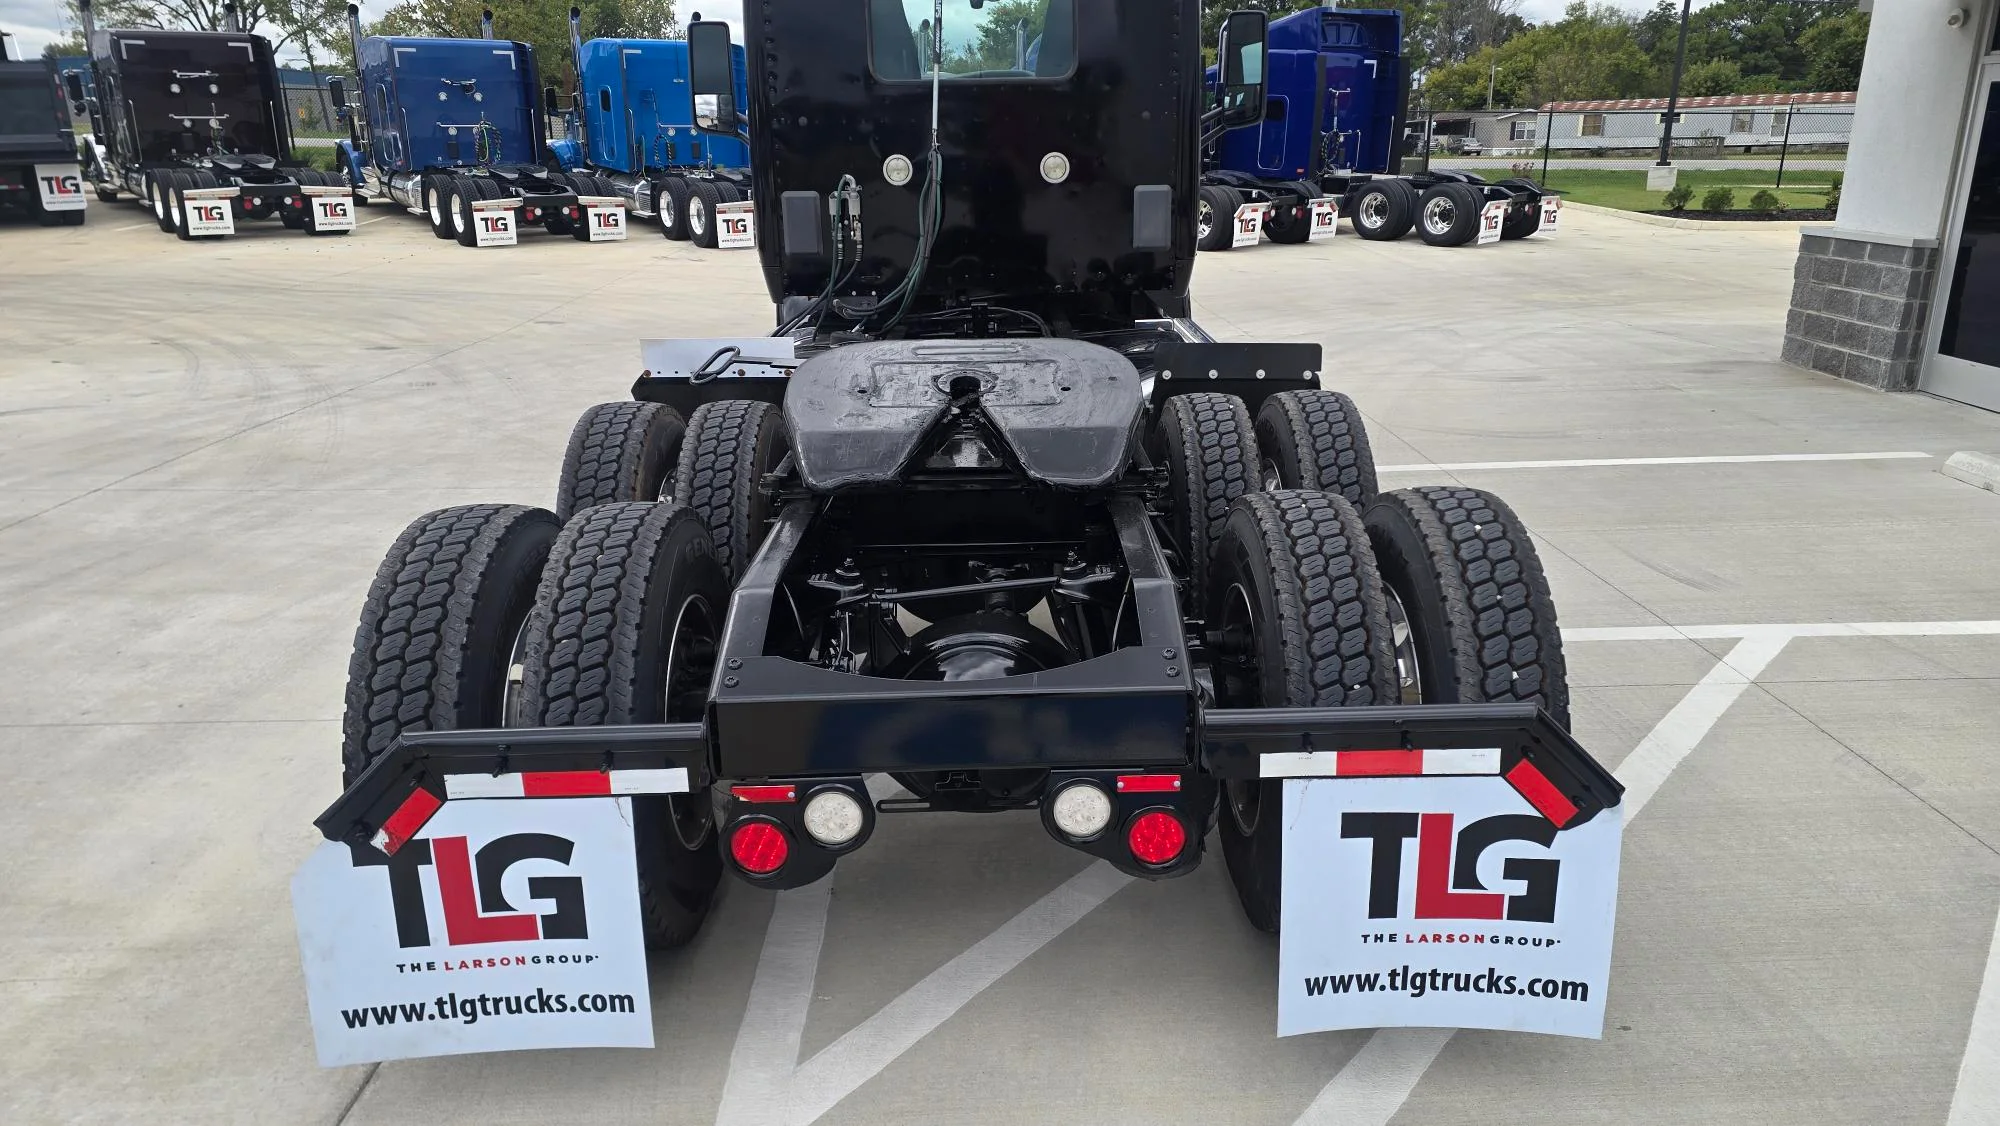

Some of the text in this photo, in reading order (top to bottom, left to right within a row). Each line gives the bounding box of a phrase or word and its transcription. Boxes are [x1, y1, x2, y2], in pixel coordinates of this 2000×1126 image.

[40, 175, 82, 195] TLG
[193, 205, 225, 222] TLG
[318, 202, 348, 218] TLG
[1543, 209, 1558, 224] TLG
[480, 216, 509, 232] TLG
[593, 212, 619, 228] TLG
[722, 218, 747, 234] TLG
[1238, 217, 1257, 234] TLG
[1315, 212, 1333, 227] TLG
[1484, 214, 1499, 231] TLG
[1340, 812, 1561, 924] TLG
[351, 832, 589, 949] TLG
[1361, 933, 1555, 948] THE LARSON GROUP
[396, 954, 594, 973] THE LARSON GROUP
[1304, 965, 1589, 1002] www.tlgtrucks.com
[341, 988, 635, 1029] www.tlgtrucks.com
